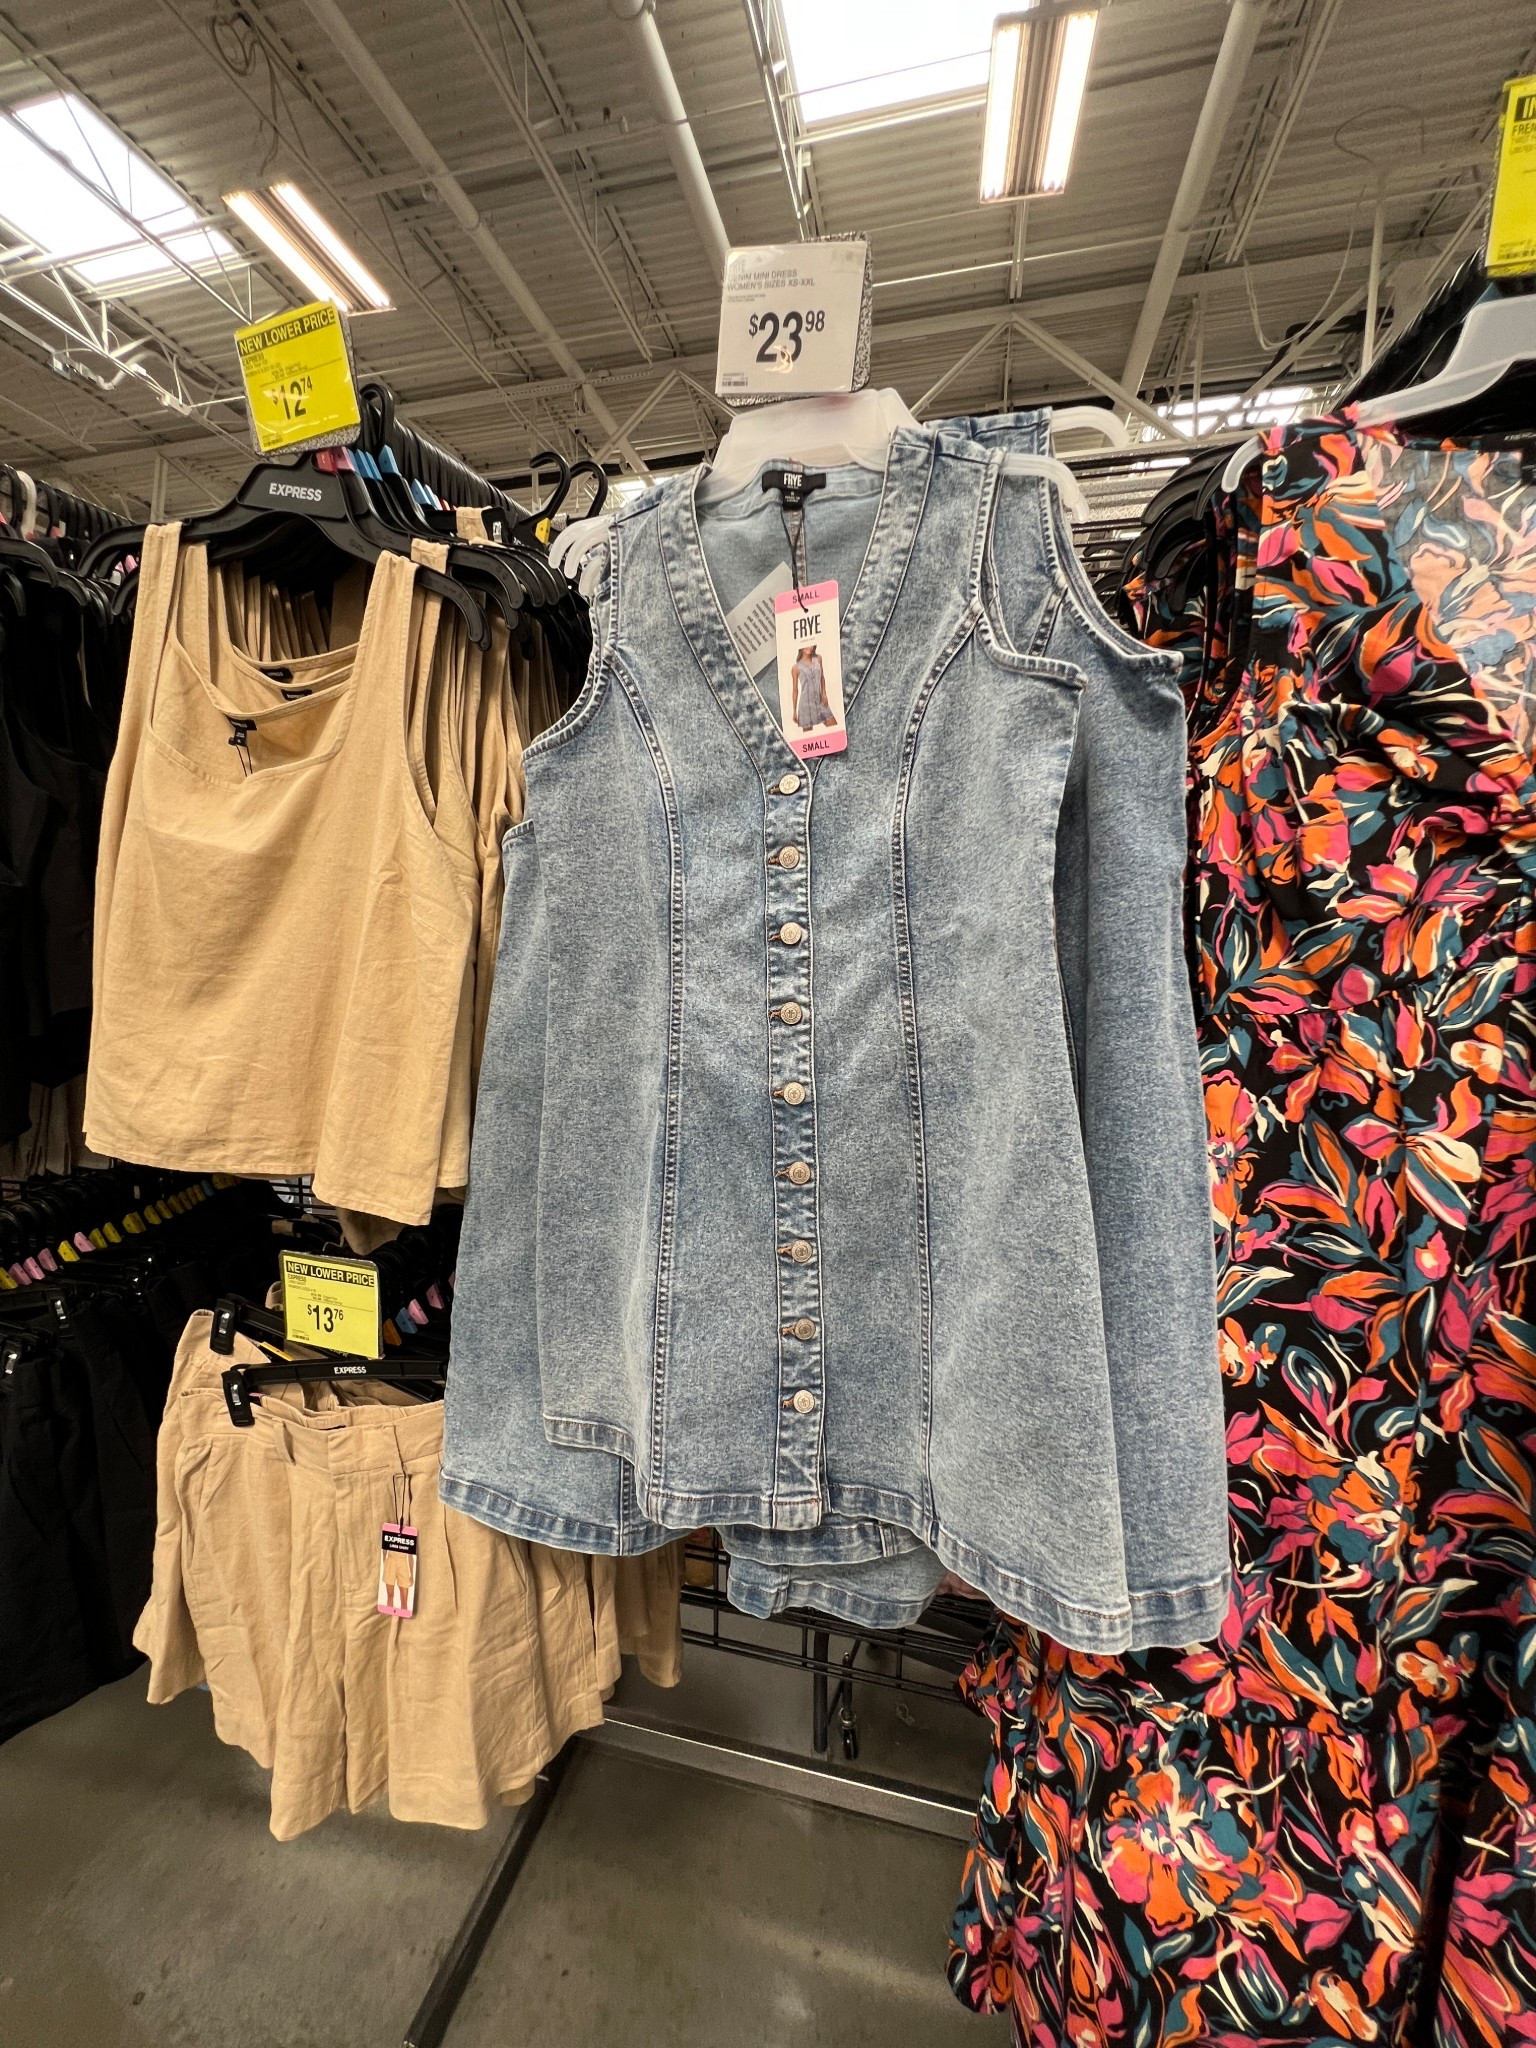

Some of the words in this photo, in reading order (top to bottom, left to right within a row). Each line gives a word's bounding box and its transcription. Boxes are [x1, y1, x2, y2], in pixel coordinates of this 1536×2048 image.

[753, 270, 770, 281] MINI
[771, 268, 798, 280] DRESS
[727, 280, 763, 292] WOMEN'S
[763, 278, 787, 289] SIZES
[787, 277, 816, 288] XS-XXL
[239, 334, 263, 356] NEW
[264, 319, 302, 347] LOWER
[302, 308, 336, 333] PRICE
[783, 472, 803, 487] FRYE
[269, 482, 322, 502] EXPRESS
[793, 614, 822, 640] FRYE
[802, 740, 830, 753] SMALL
[287, 1261, 308, 1275] NEW
[310, 1267, 344, 1281] LOWER
[346, 1272, 375, 1287] PRICE
[333, 1366, 367, 1375] EXPRESS
[384, 1535, 415, 1546] EXPRESS
